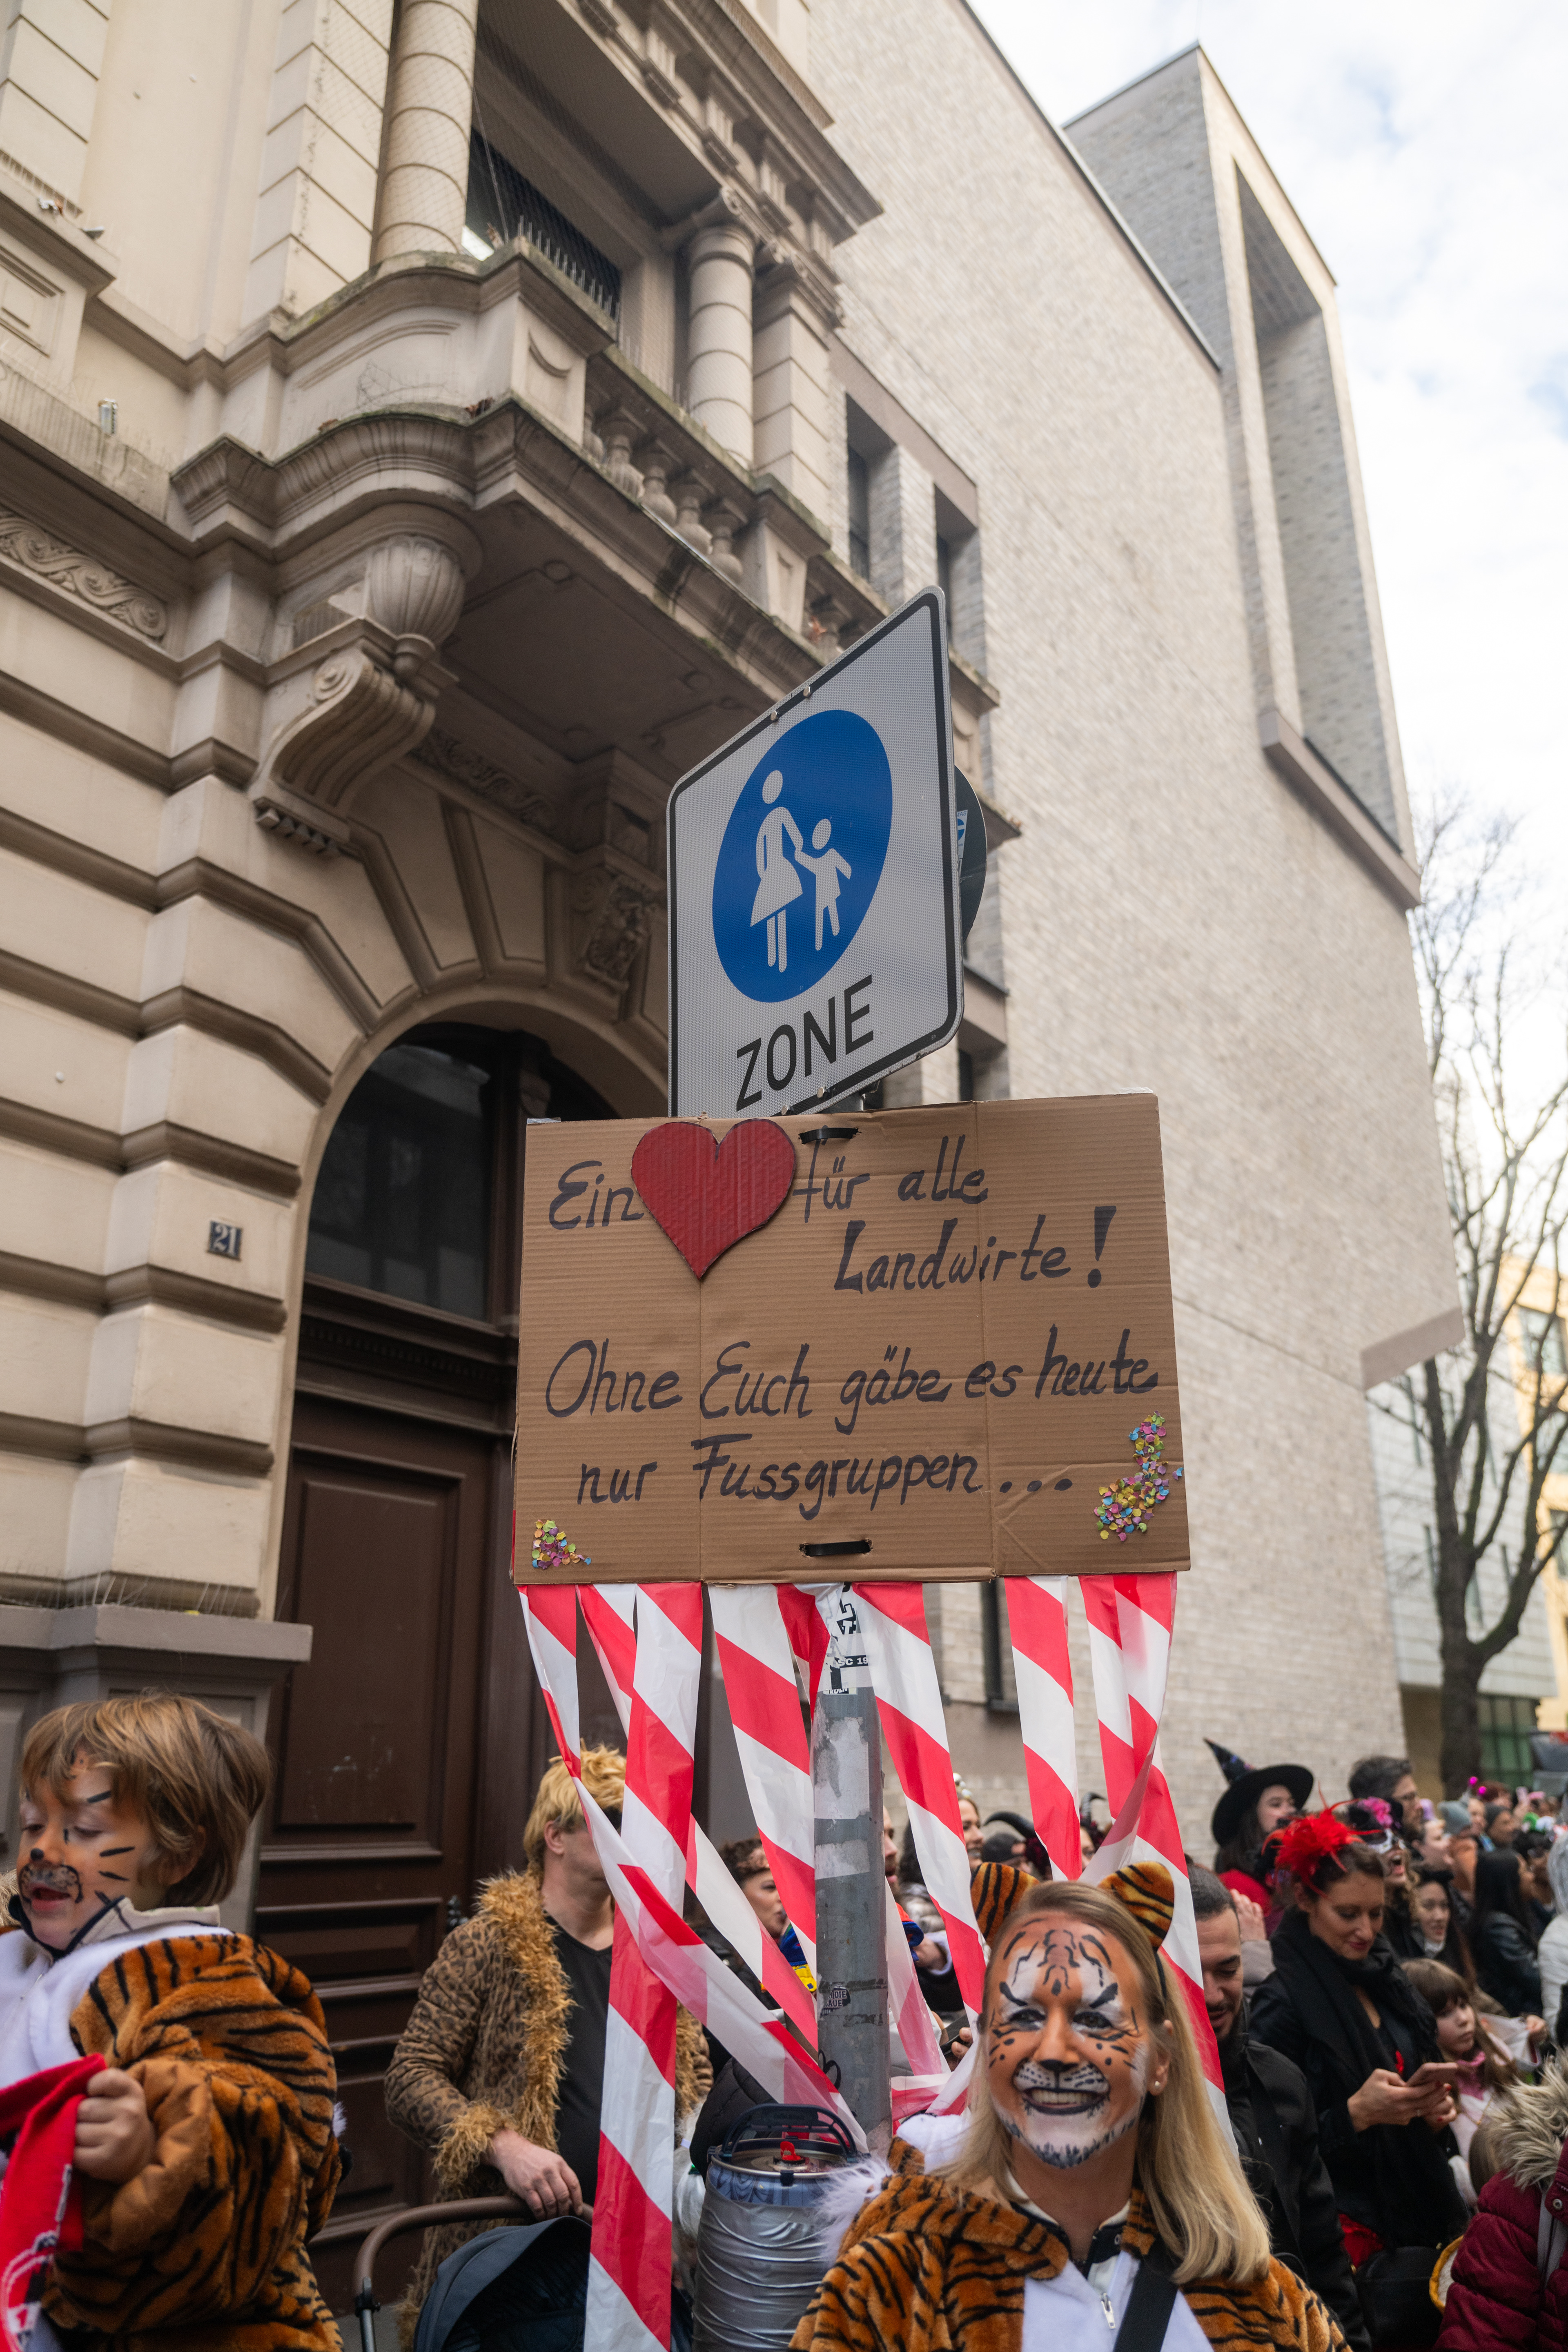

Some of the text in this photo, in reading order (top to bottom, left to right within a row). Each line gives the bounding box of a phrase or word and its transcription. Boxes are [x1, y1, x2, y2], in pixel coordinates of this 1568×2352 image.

[737, 975, 873, 1111] ZONE
[549, 1126, 989, 1230] Ein für alle
[213, 1225, 236, 1256] 21
[546, 1323, 1159, 1435] Ohne Euch gäbe es heute
[578, 1461, 657, 1505] nur
[834, 1990, 847, 1999] DIE
